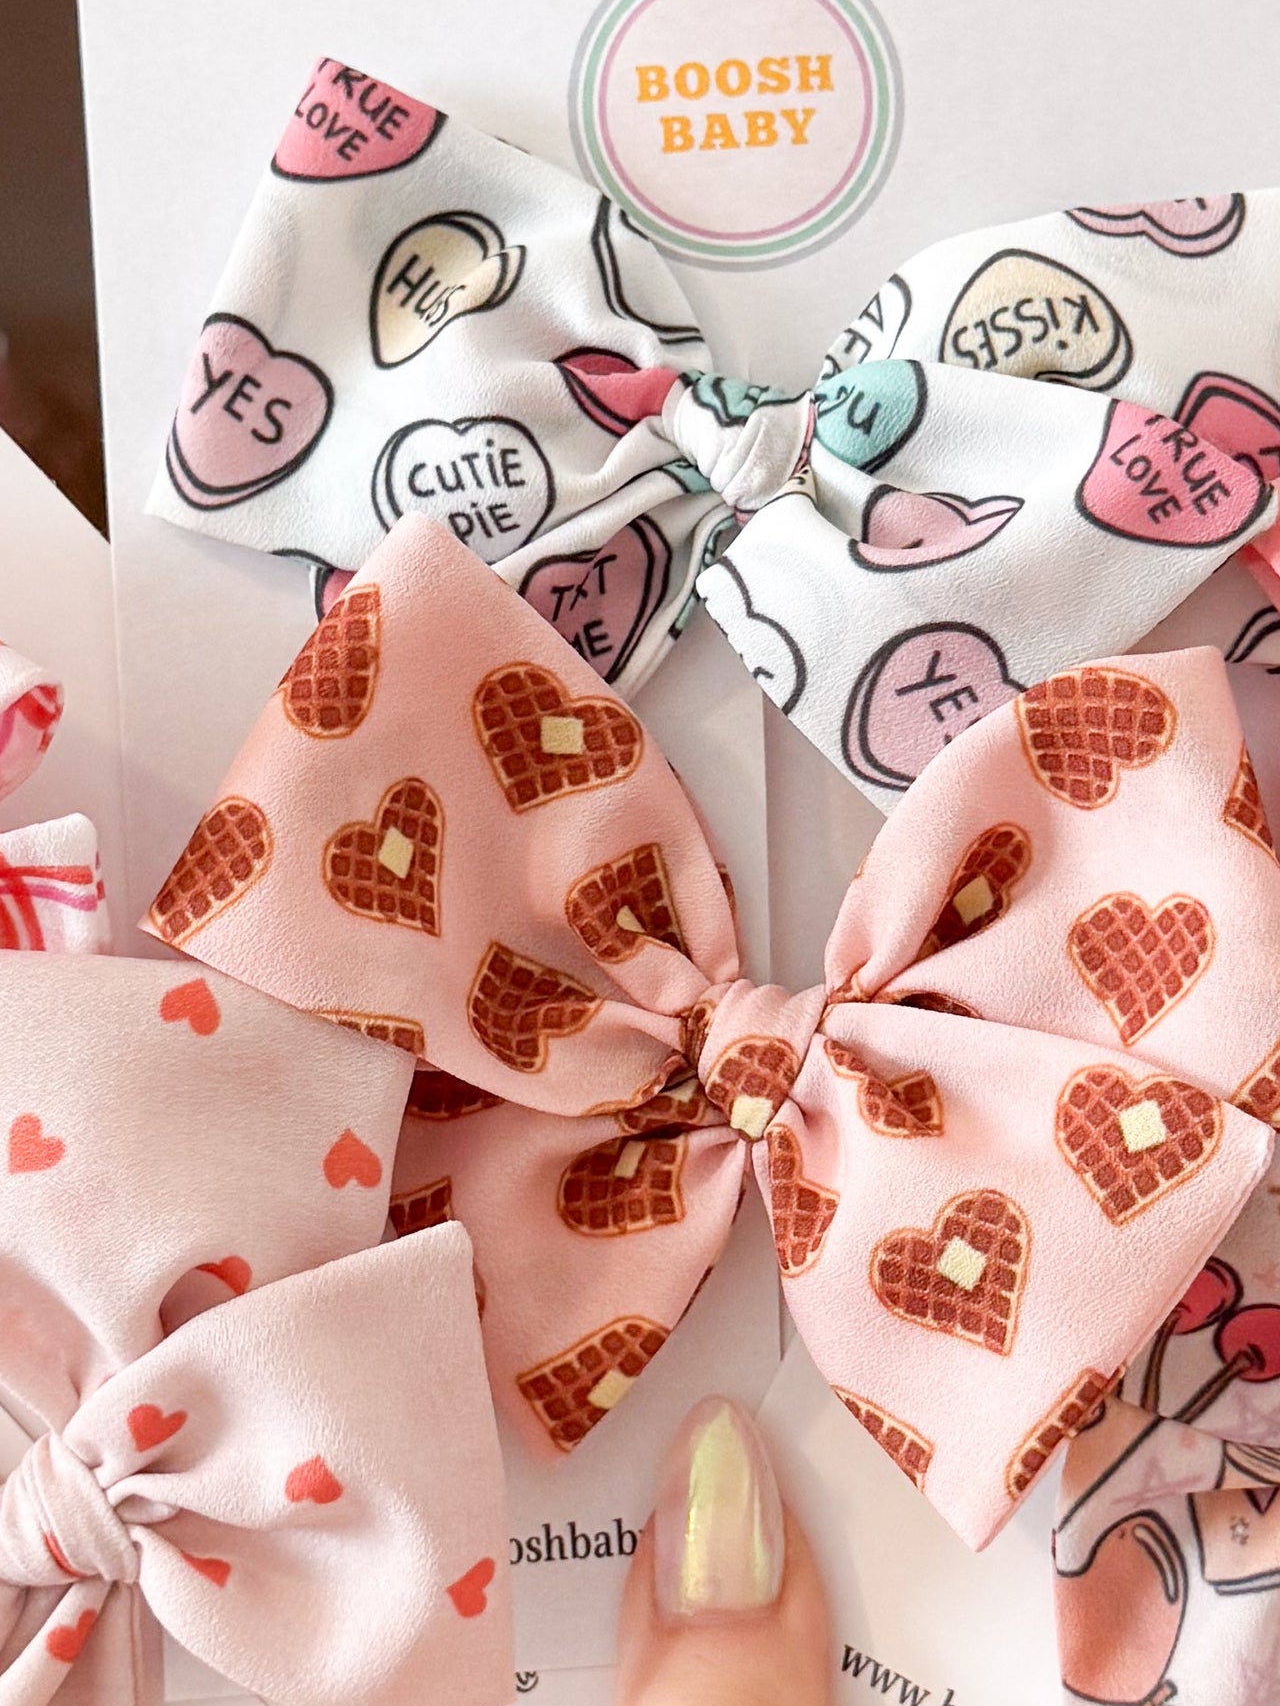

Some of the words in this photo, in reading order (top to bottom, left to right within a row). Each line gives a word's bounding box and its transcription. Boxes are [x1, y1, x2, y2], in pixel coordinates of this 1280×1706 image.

[318, 58, 410, 141] RUE
[636, 54, 836, 103] BOOSH
[660, 108, 817, 154] BABY
[190, 351, 293, 445] YES
[1109, 433, 1184, 525] LOVE
[895, 649, 981, 746] YE
